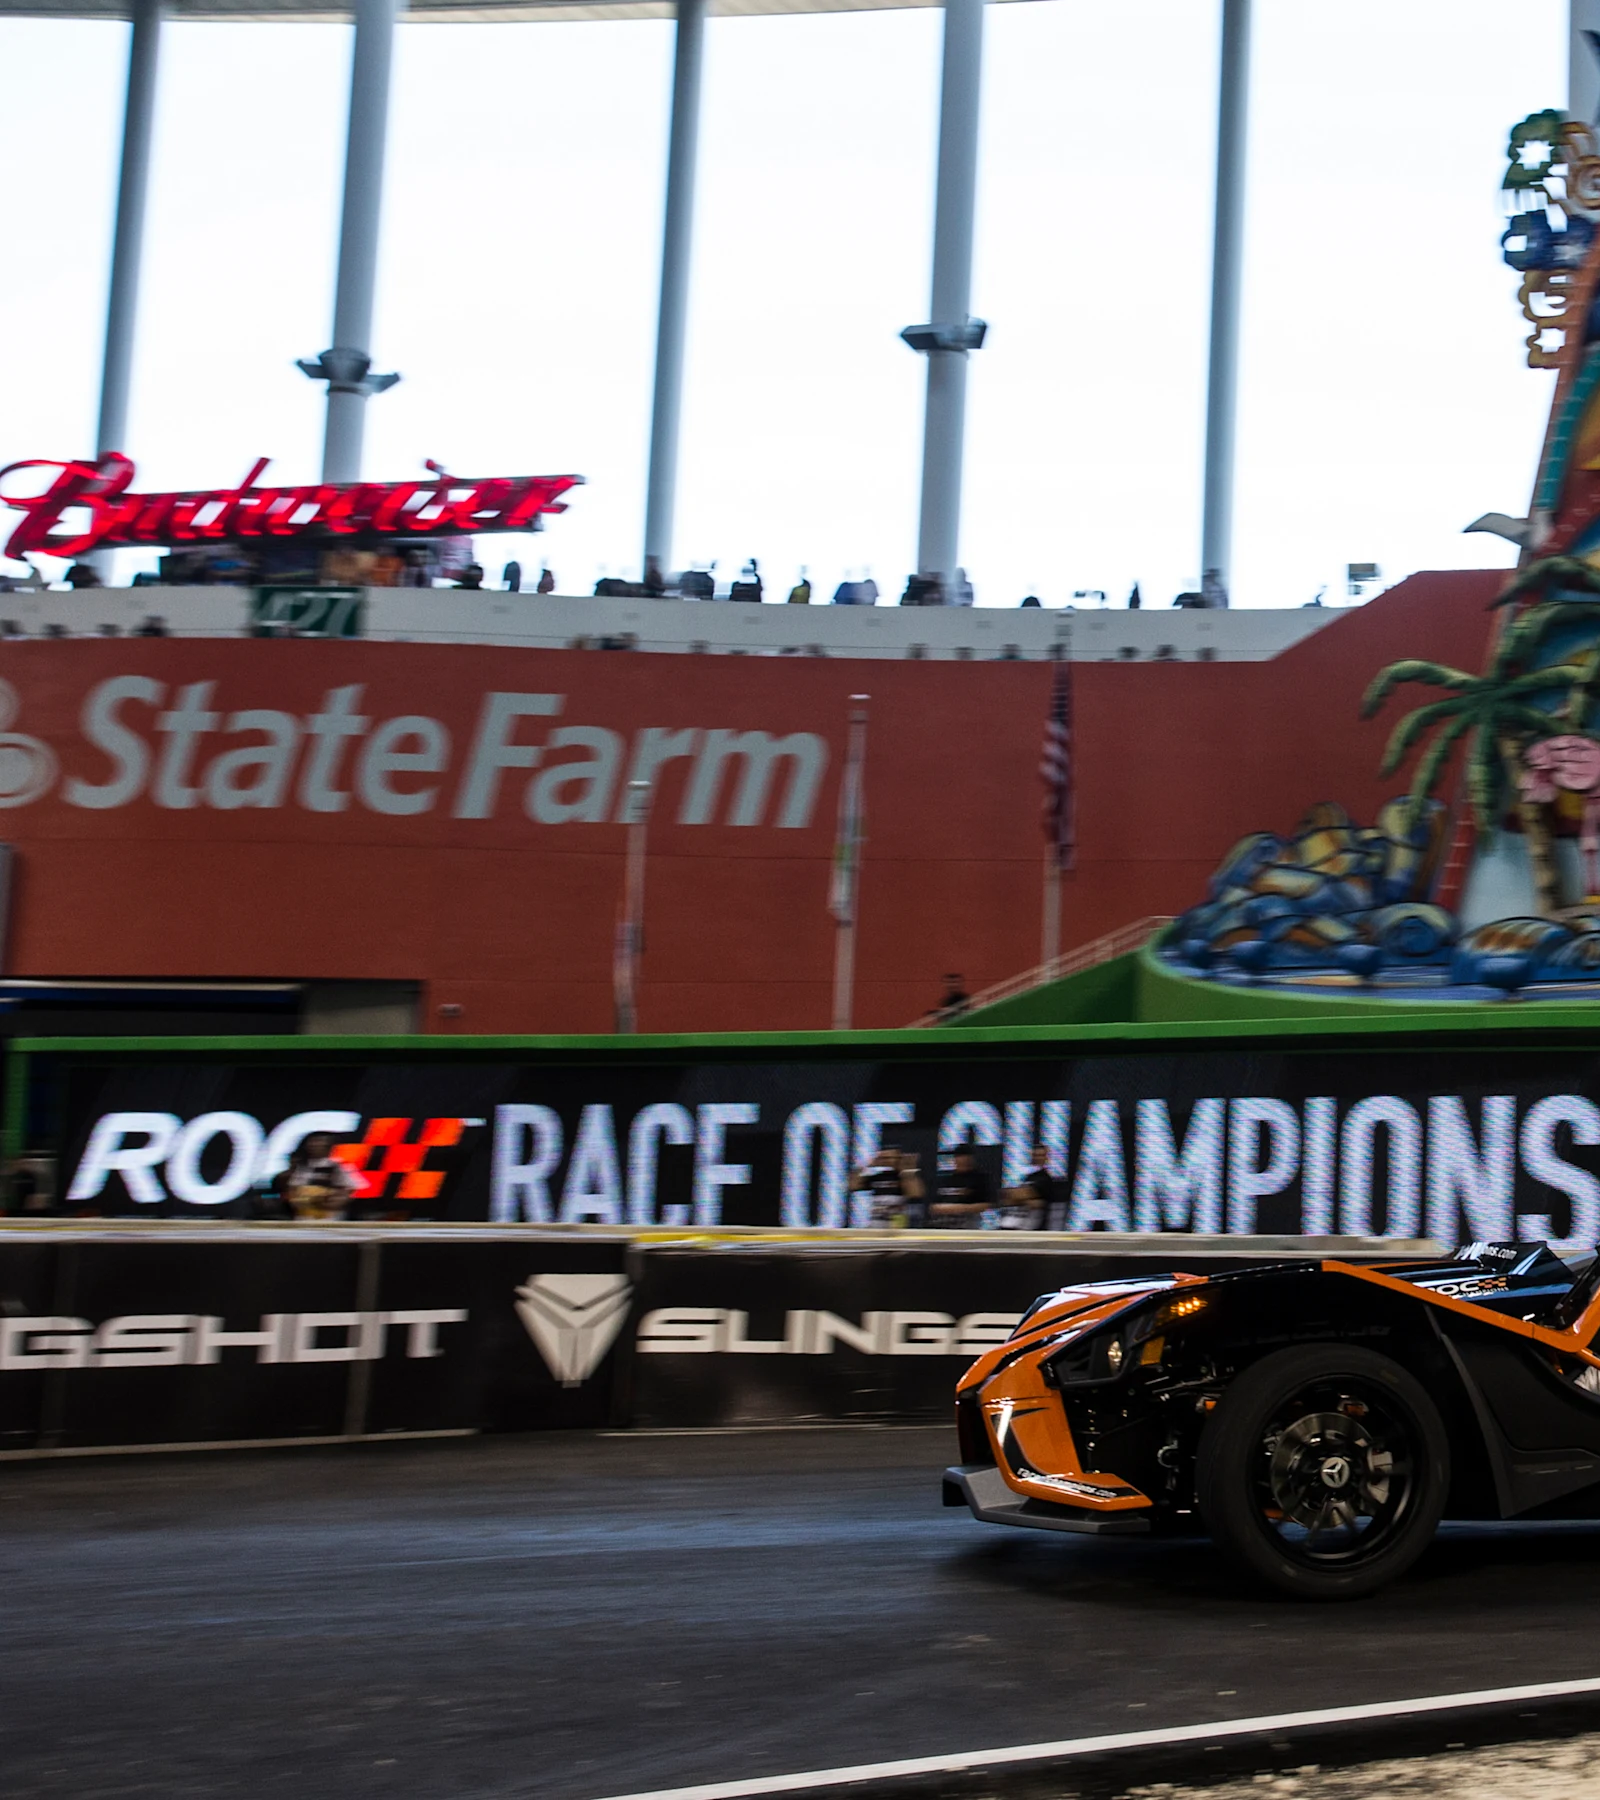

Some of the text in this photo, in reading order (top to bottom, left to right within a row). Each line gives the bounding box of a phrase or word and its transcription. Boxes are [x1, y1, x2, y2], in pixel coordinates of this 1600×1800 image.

[64, 675, 829, 828] State Farm
[489, 1103, 760, 1226] RACE
[783, 1102, 915, 1228] OF
